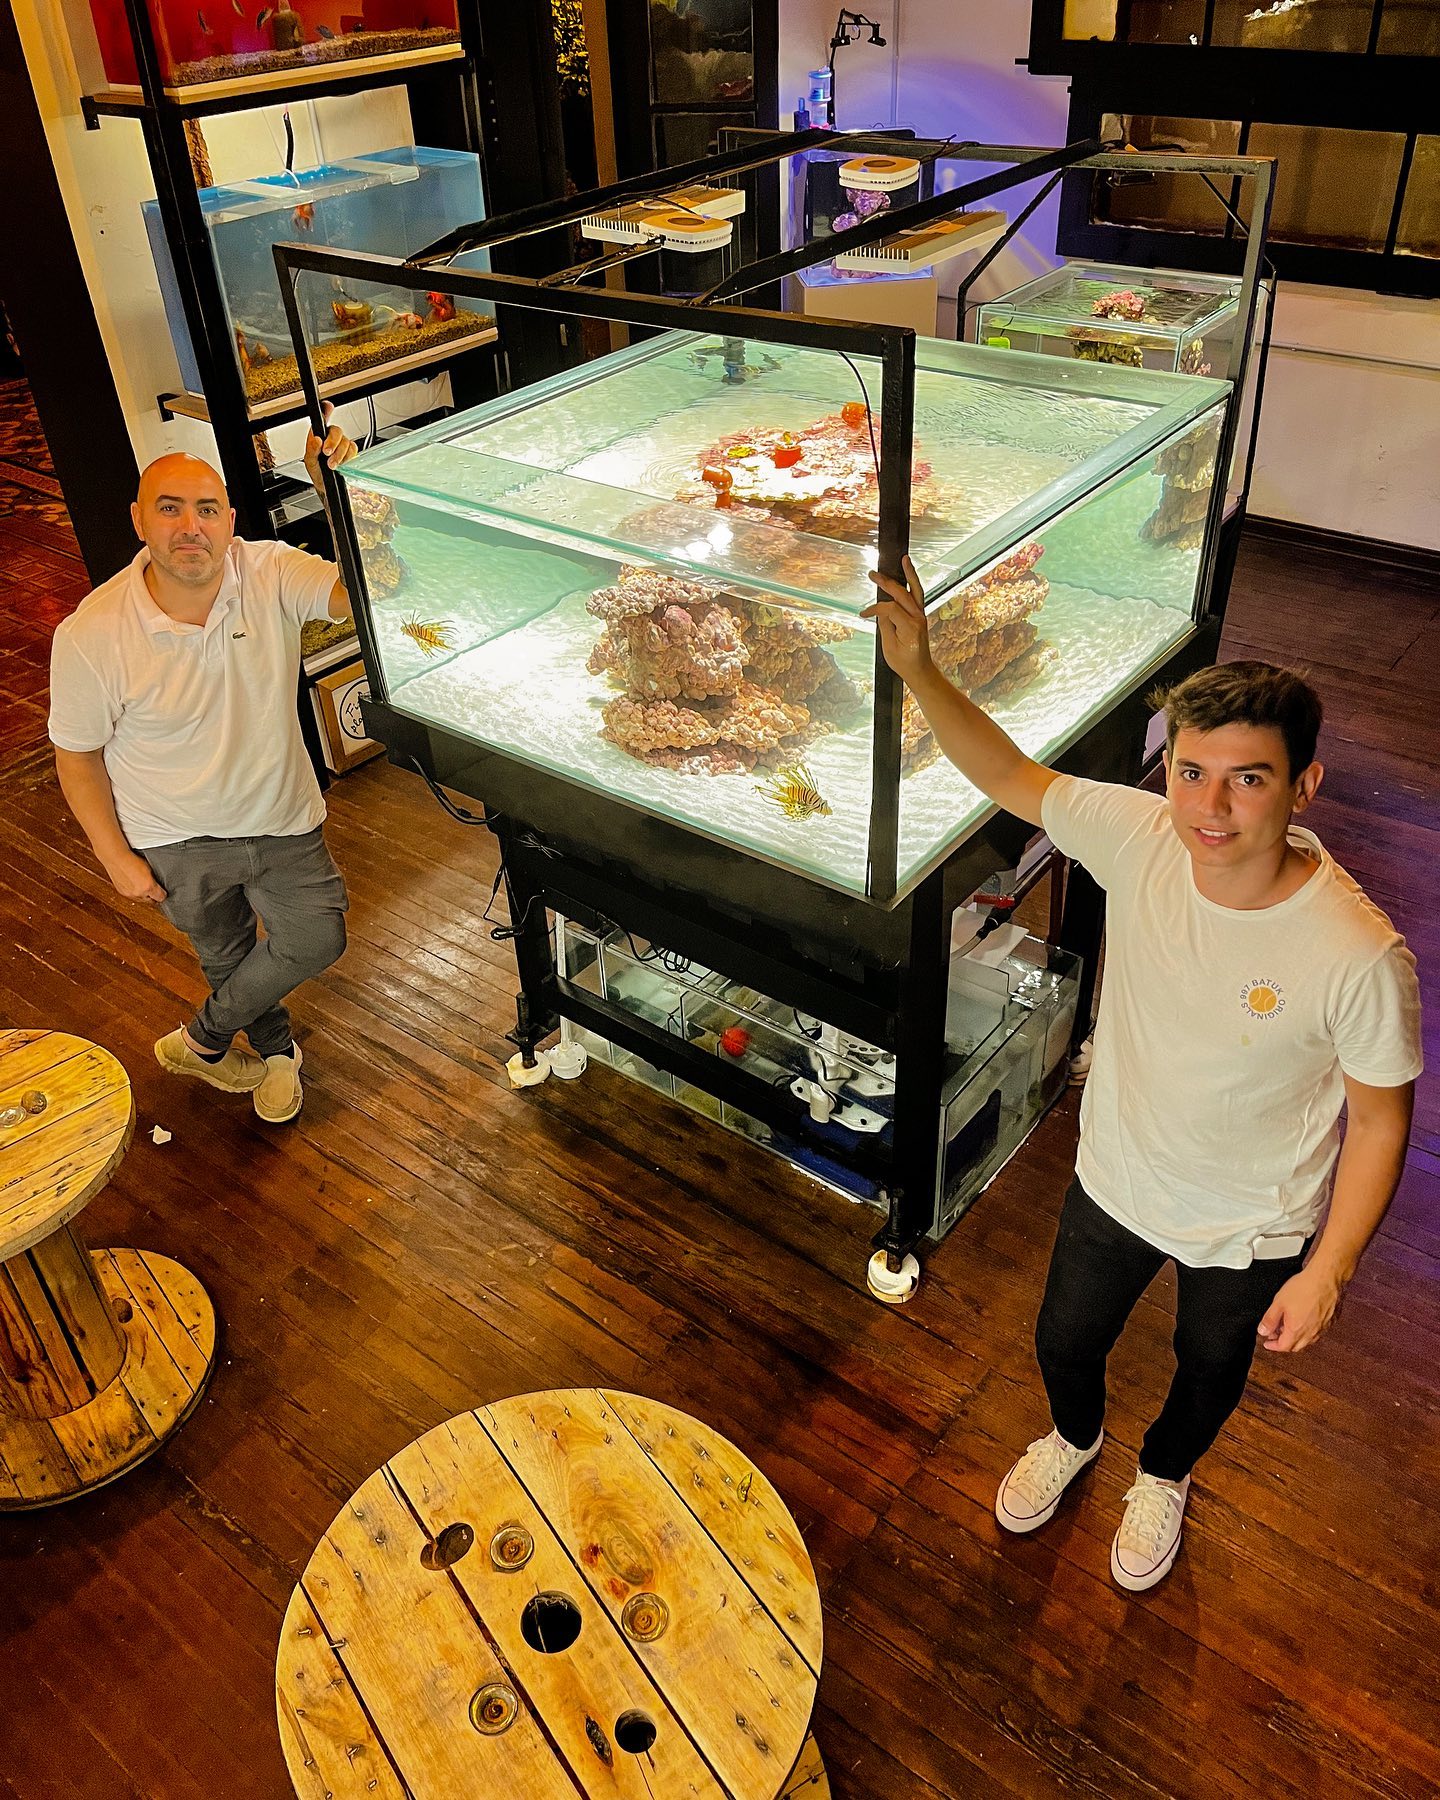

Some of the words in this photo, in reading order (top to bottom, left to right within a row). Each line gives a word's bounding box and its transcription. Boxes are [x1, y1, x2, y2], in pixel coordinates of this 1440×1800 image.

[1240, 984, 1250, 1000] 997
[1251, 978, 1284, 995] BATUK
[1241, 999, 1286, 1020] ORIGINALS
